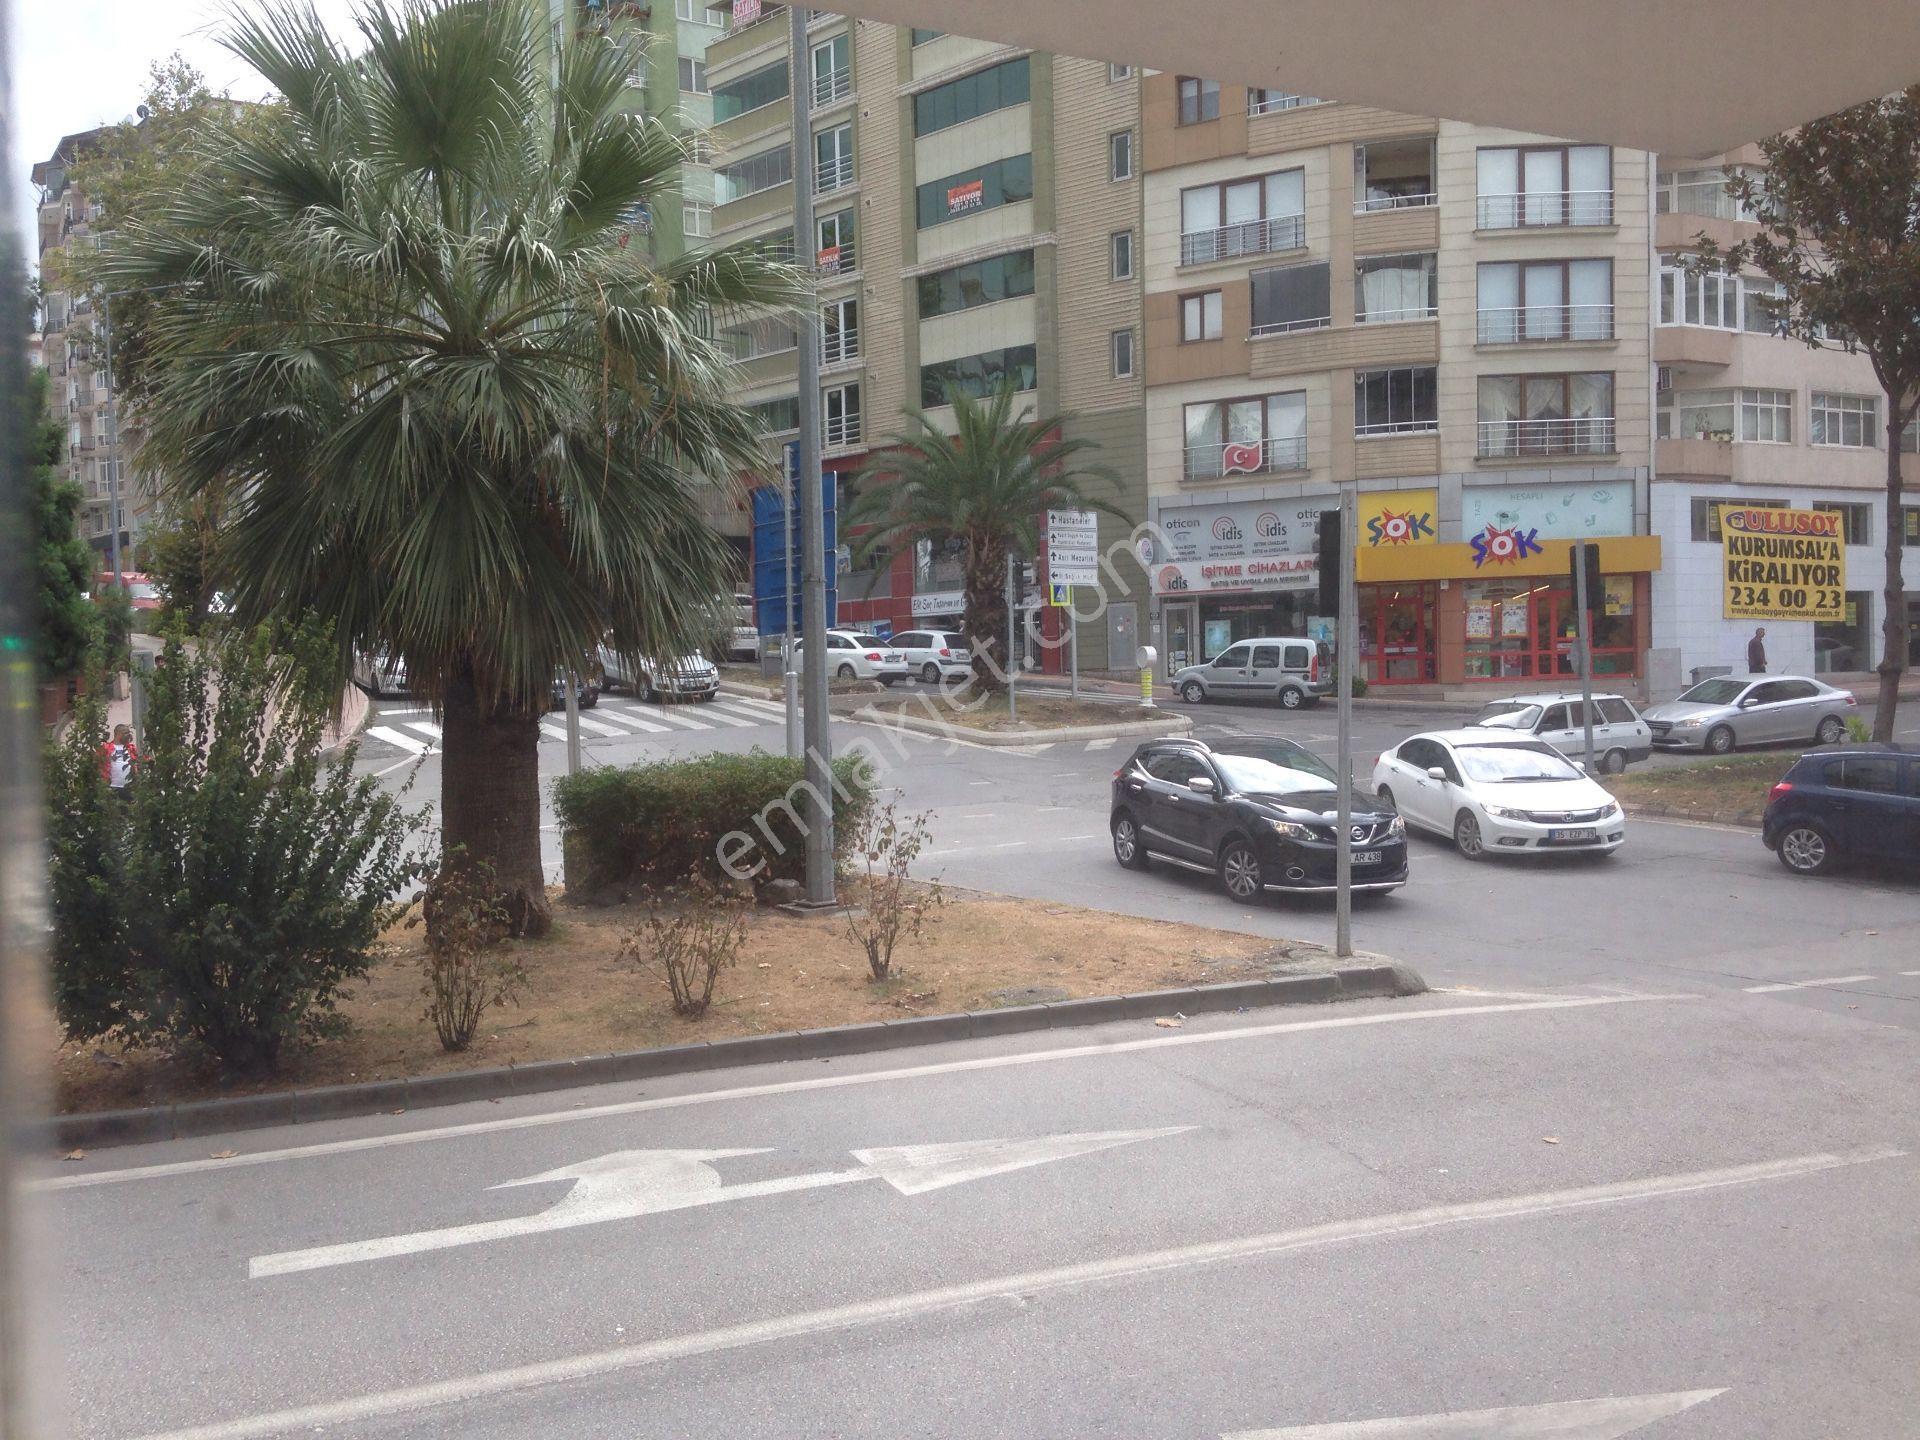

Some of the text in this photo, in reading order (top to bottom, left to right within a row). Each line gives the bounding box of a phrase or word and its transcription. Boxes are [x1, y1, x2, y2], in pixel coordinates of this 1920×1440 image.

[1297, 508, 1320, 520] otic
[1743, 510, 1840, 536] ULUSOY
[1166, 518, 1200, 530] oticon
[1222, 525, 1243, 541] idis
[1265, 522, 1287, 537] idis
[1366, 511, 1435, 548] ŞOK
[1470, 526, 1544, 569] ŞOK
[1728, 535, 1841, 561] KURUMSAL'A
[1201, 557, 1318, 580] İŞİTME CİHAZLAR
[1167, 575, 1188, 590] idis
[1730, 586, 1841, 609] 234 00 23
[1355, 853, 1366, 862] AR
